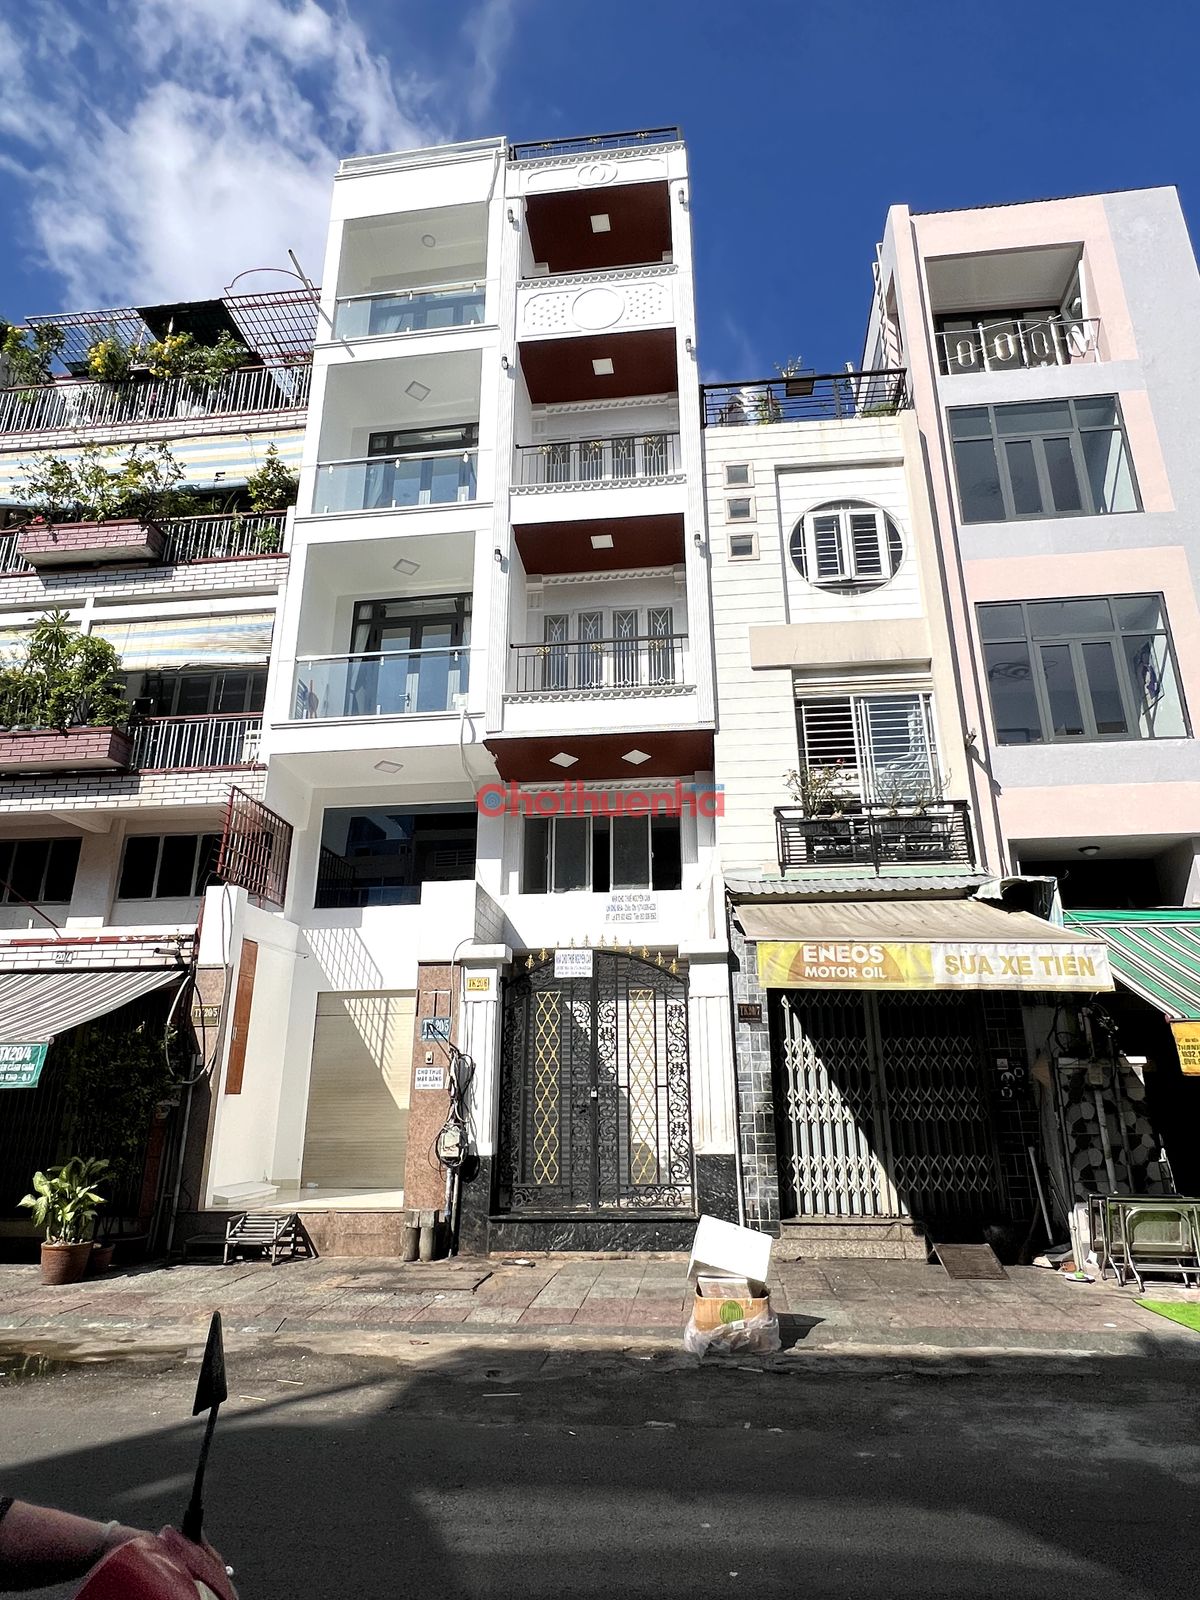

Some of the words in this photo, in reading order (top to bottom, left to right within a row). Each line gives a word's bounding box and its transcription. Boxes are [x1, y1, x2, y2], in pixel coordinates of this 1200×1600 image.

[802, 944, 885, 964] ENEOS
[804, 966, 857, 978] MOTOR
[861, 966, 887, 979] OIL
[1000, 955, 1034, 976] XE
